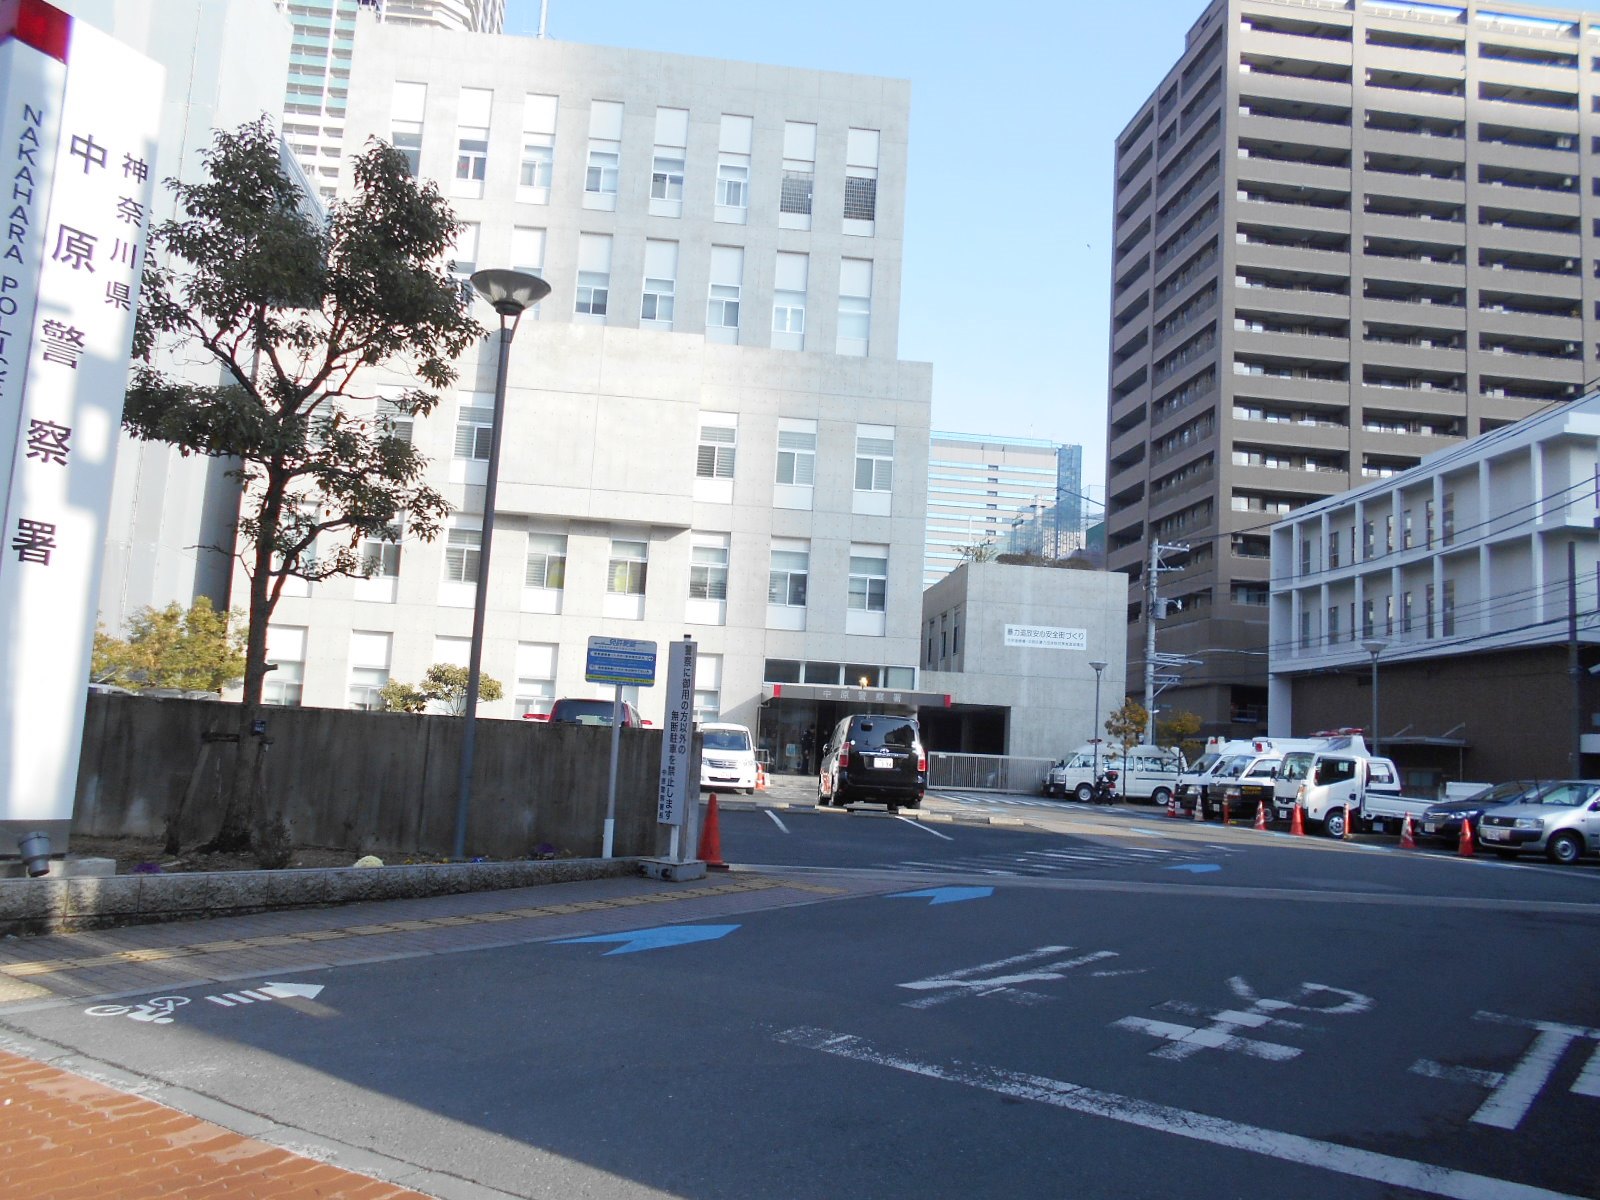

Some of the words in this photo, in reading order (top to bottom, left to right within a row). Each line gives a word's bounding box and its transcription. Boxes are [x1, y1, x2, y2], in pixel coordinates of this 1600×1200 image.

[4, 103, 43, 265] NAKAHARA
[104, 151, 149, 312] 神奈川県
[12, 133, 108, 567] 中原警察署
[665, 711, 679, 820] 無断駐車を禁止します
[677, 644, 692, 755] 警察に御用の方以外の
